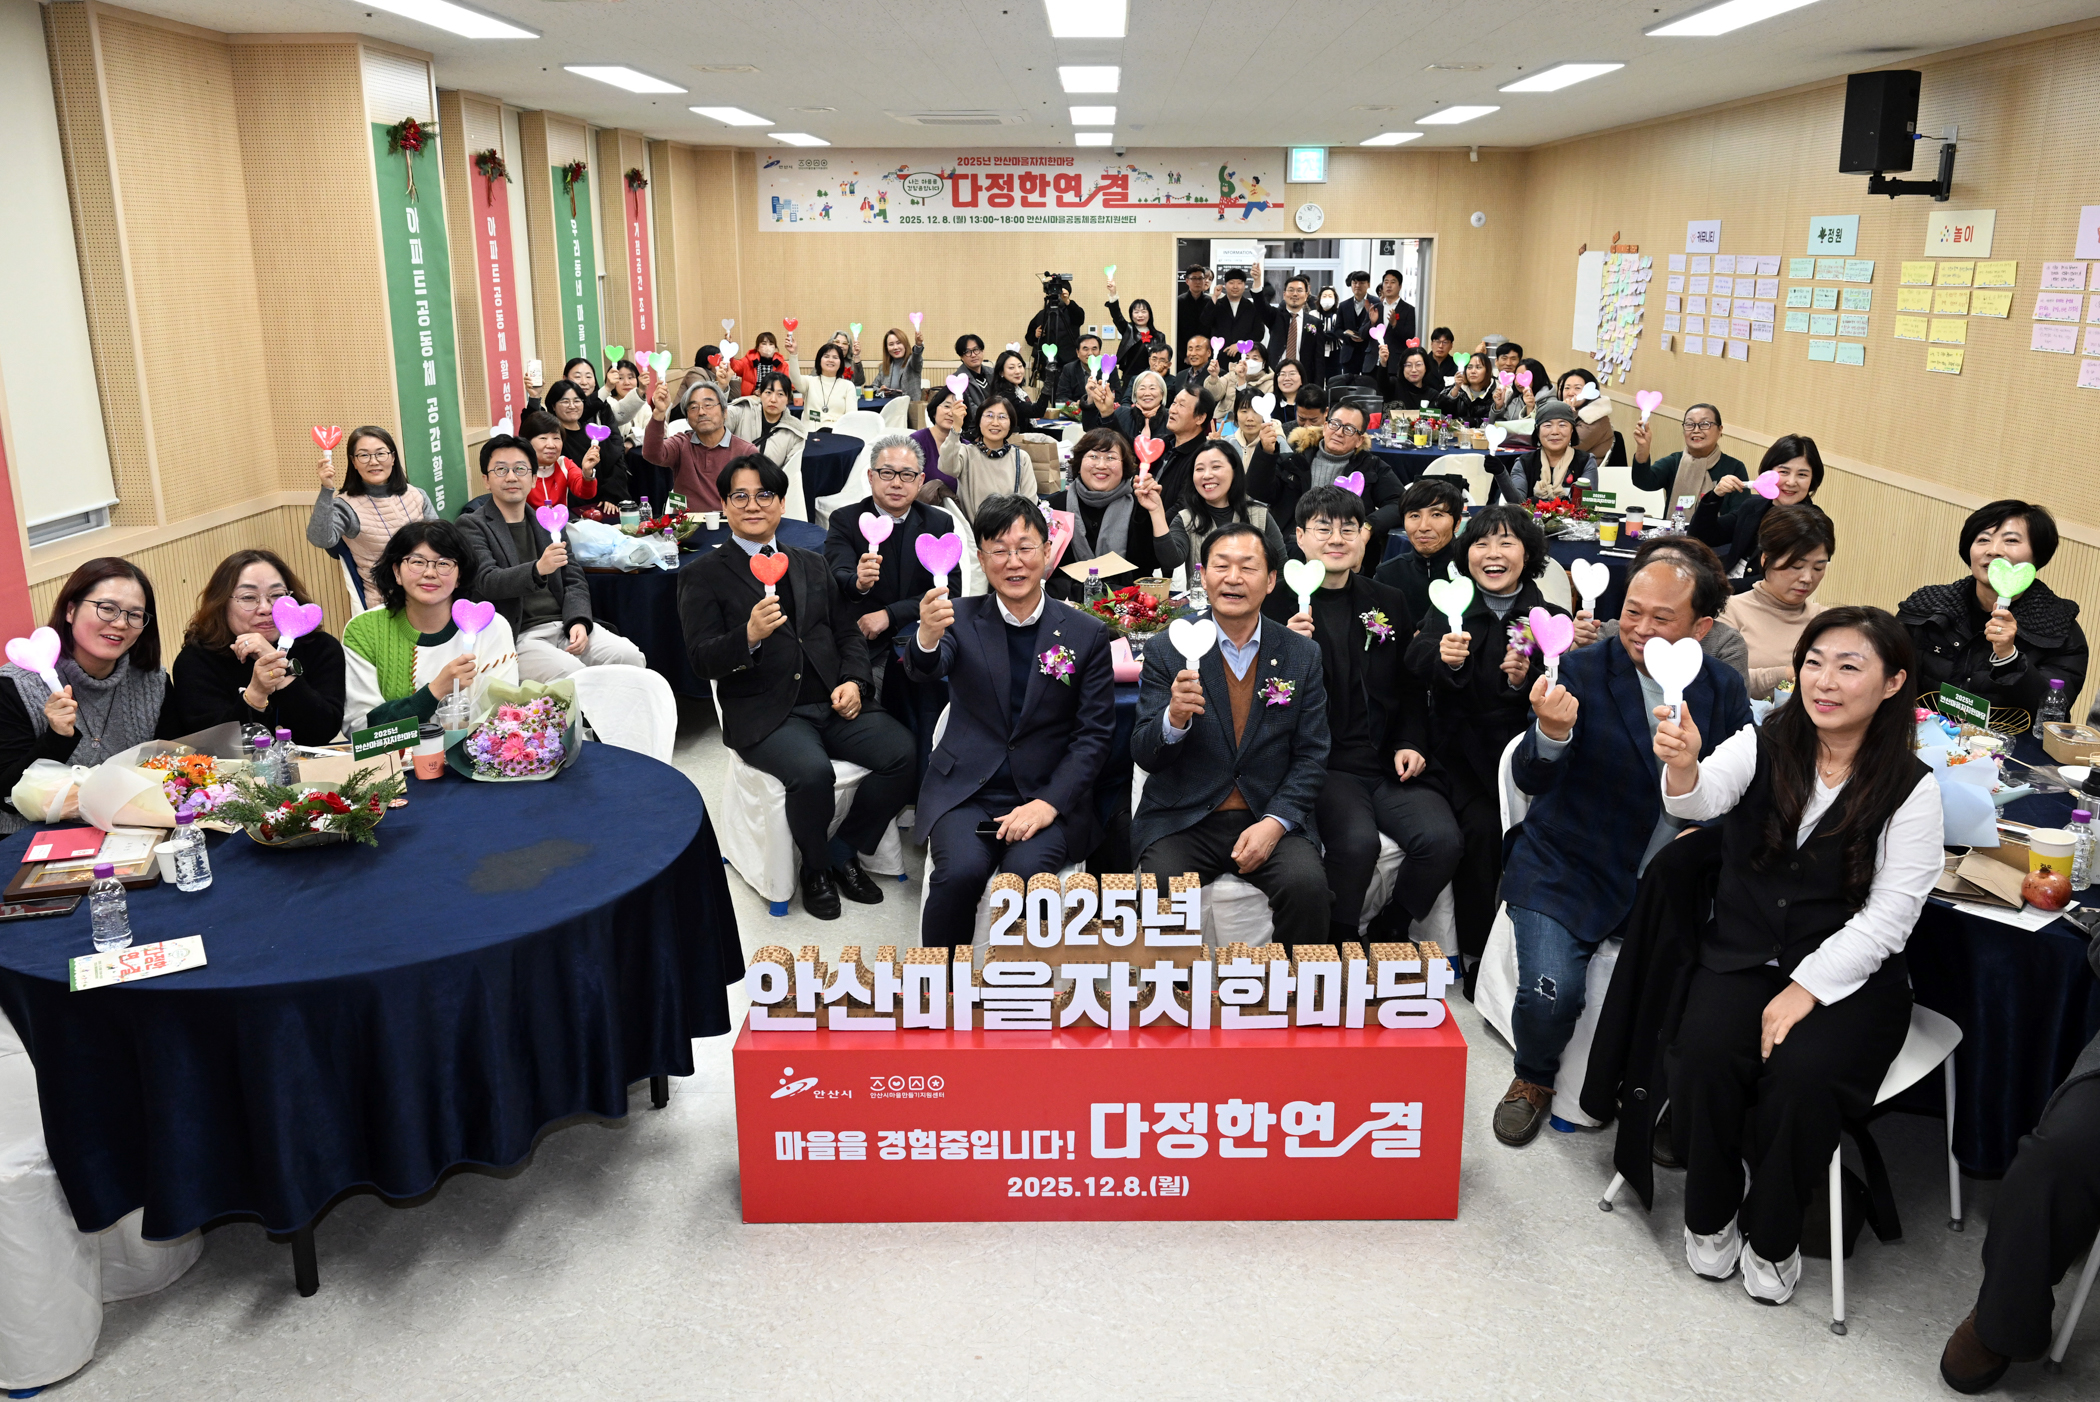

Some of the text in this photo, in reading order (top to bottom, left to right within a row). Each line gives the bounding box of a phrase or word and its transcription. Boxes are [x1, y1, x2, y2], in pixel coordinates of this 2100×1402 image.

[957, 157, 1075, 166] 2025년 안산마을자치한마당
[900, 215, 925, 224] 2025.
[928, 216, 941, 224] 12.
[942, 216, 951, 224] 8.
[953, 215, 967, 224] (월)
[969, 215, 1025, 224] 13:00~18:00
[1697, 231, 1715, 243] 커뮤니티
[1827, 228, 1843, 243] 정원
[1953, 225, 1974, 243] 놀이
[570, 219, 583, 297] 우리동네
[487, 216, 507, 352] 아파트공동체
[406, 207, 445, 512] 아파트공동체 공감활동
[355, 730, 418, 753] 안산마을자치한마당
[374, 727, 399, 739] 2025년
[989, 887, 1202, 948] 2025년
[745, 957, 1455, 1031] 안산마을자치한마당
[813, 1089, 852, 1099] 안산시
[870, 1091, 945, 1099] 안산시마을만들기지원센터
[775, 1128, 1076, 1161] 마을을 경험중입니다!
[1007, 1175, 1190, 1198] 2025.12.8.(월)
